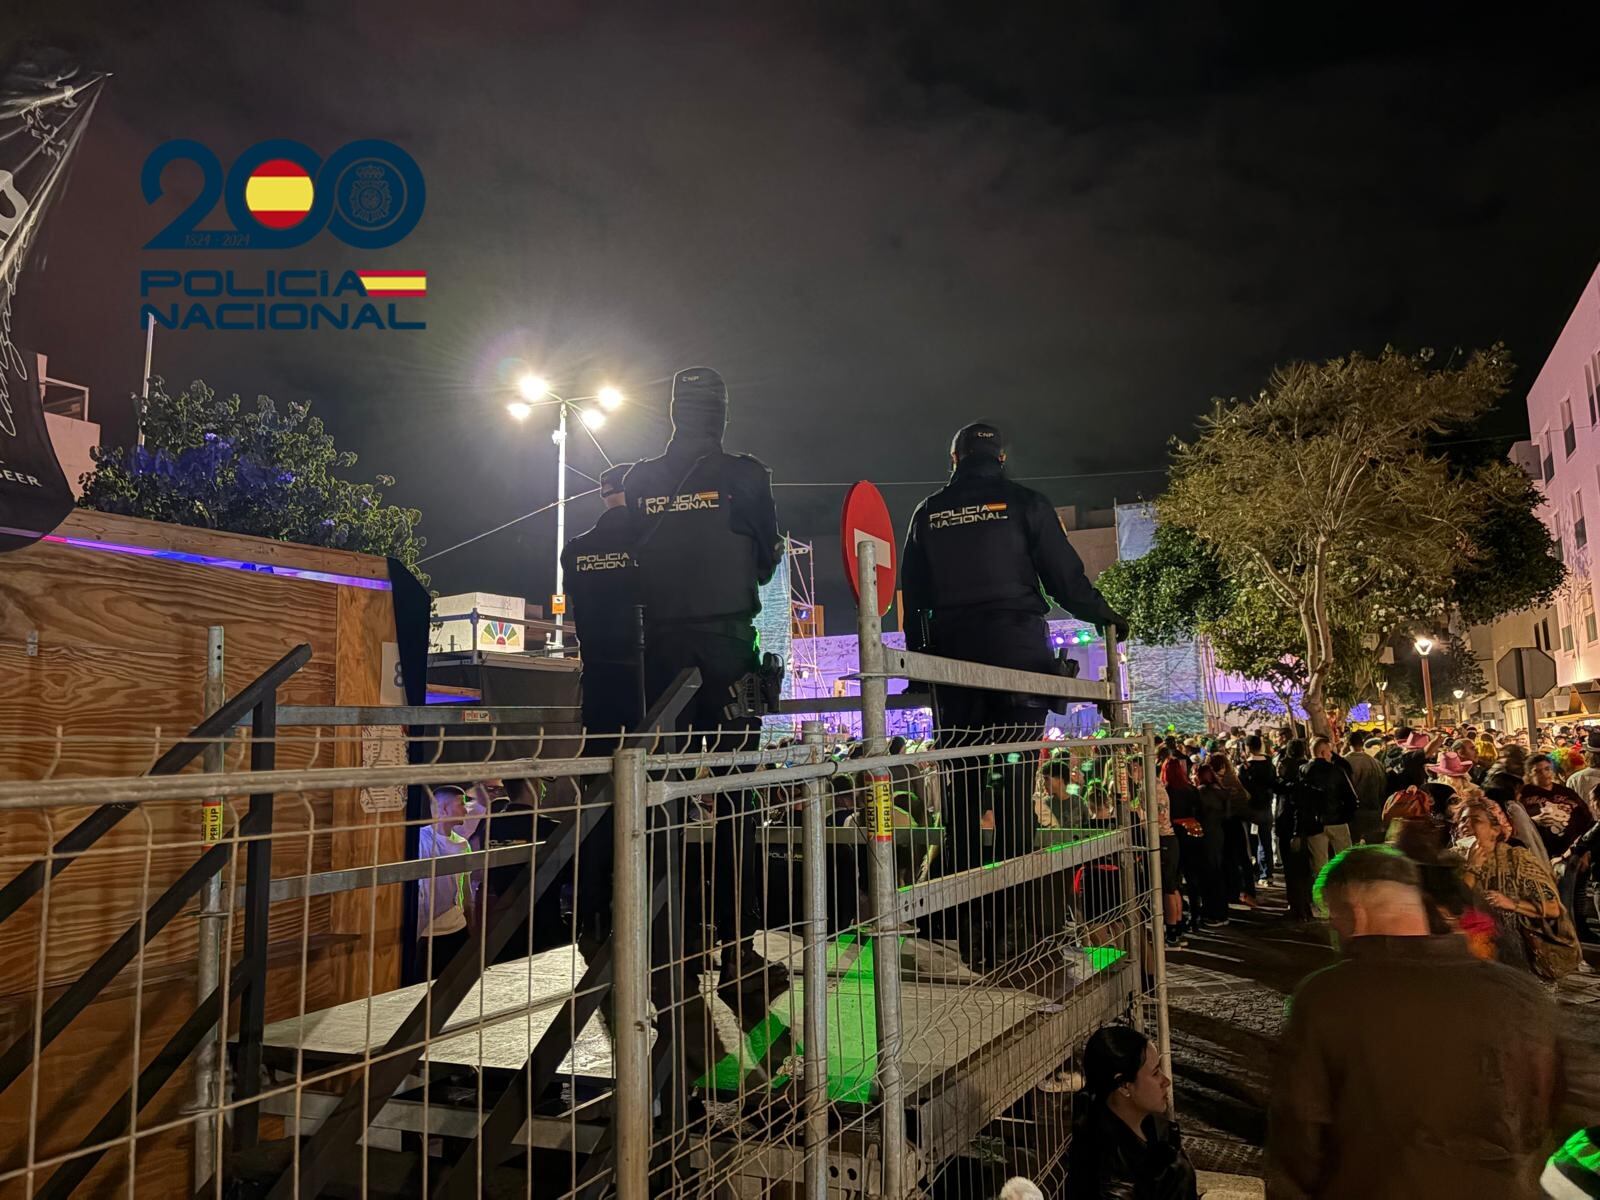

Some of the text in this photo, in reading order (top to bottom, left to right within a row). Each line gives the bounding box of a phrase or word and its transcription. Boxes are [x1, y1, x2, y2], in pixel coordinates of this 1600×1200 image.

[0, 469, 43, 488] EER
[929, 505, 990, 521] POLICIA
[930, 512, 1008, 528] NACIONAL
[576, 552, 630, 563] POLICIA
[576, 559, 639, 572] NACIONL
[883, 784, 891, 828] PERI UP
[209, 808, 218, 840] PERI UP
